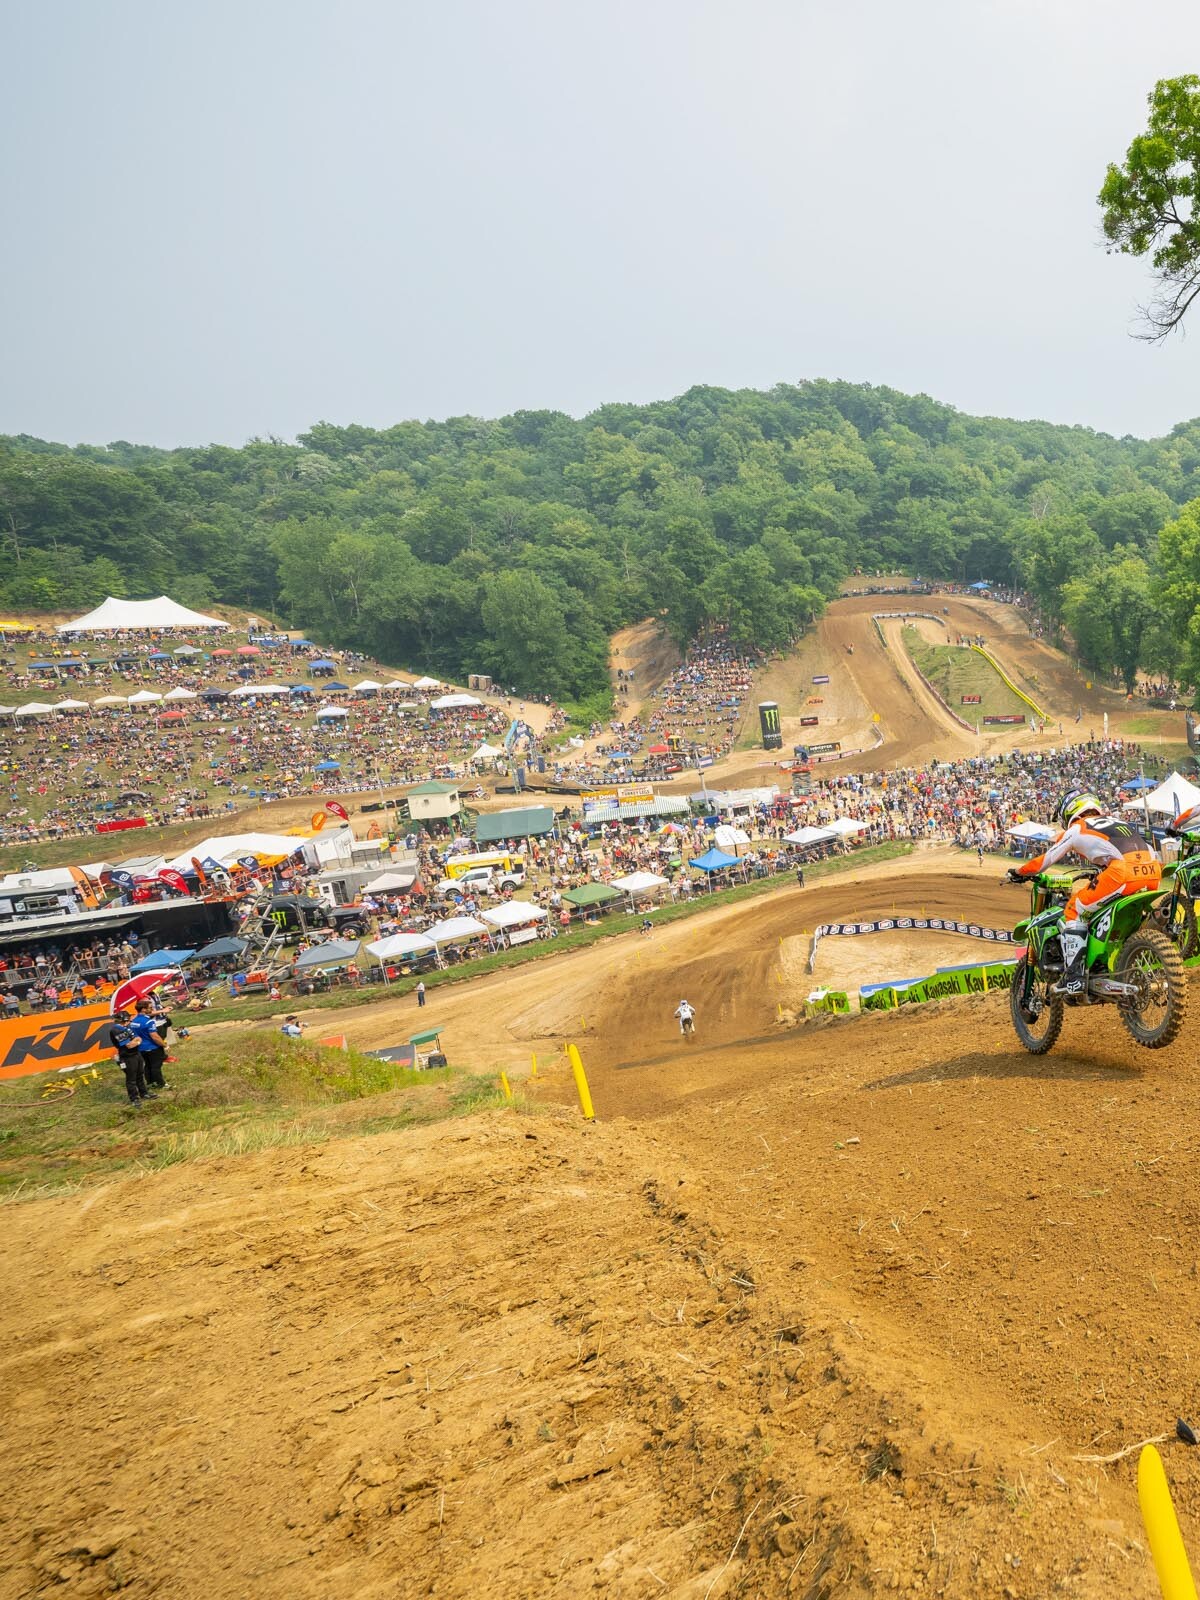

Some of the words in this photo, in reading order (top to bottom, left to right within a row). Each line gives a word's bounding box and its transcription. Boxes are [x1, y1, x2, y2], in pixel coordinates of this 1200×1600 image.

[1133, 864, 1156, 876] FOX
[922, 975, 961, 1000] Kawasaki
[964, 969, 1014, 992] Kawasak
